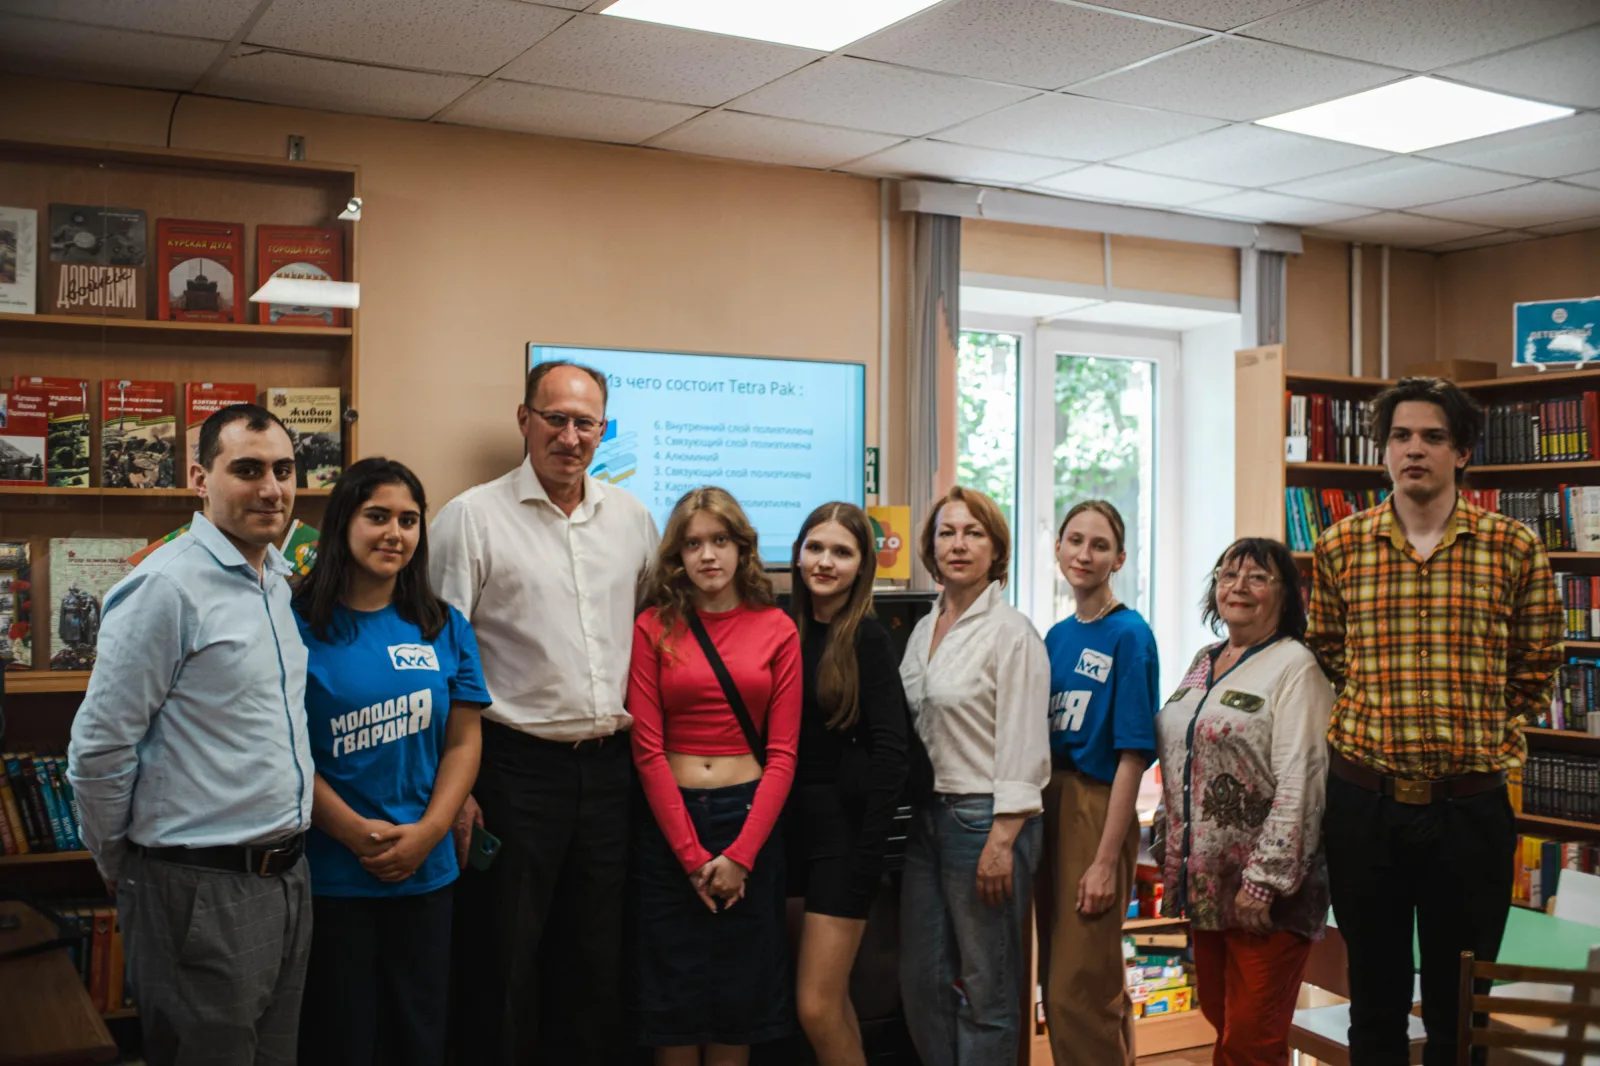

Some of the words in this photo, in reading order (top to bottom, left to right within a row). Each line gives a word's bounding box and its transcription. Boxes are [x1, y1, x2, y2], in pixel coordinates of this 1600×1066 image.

[168, 239, 207, 248] КУРСКАЯ
[210, 240, 233, 250] ДУГА
[56, 263, 137, 309] ДОРОГАМИ
[607, 374, 621, 388] Из
[626, 378, 662, 390] чего
[666, 379, 725, 393] состоит
[728, 379, 766, 395] Tetra
[770, 381, 796, 396] Pak
[665, 420, 725, 434] Внутренний
[728, 423, 750, 433] слой
[753, 425, 813, 436] полиэтилена
[665, 436, 723, 448] Связующий
[725, 438, 748, 448] слой
[750, 440, 811, 450] полиэтилена
[665, 451, 719, 462] Алюминий
[665, 466, 723, 479] Связующий
[725, 469, 748, 478] слой
[750, 470, 811, 480] полиэтилена
[875, 536, 900, 549] ТО
[330, 688, 432, 736] МОЛОДАЯ
